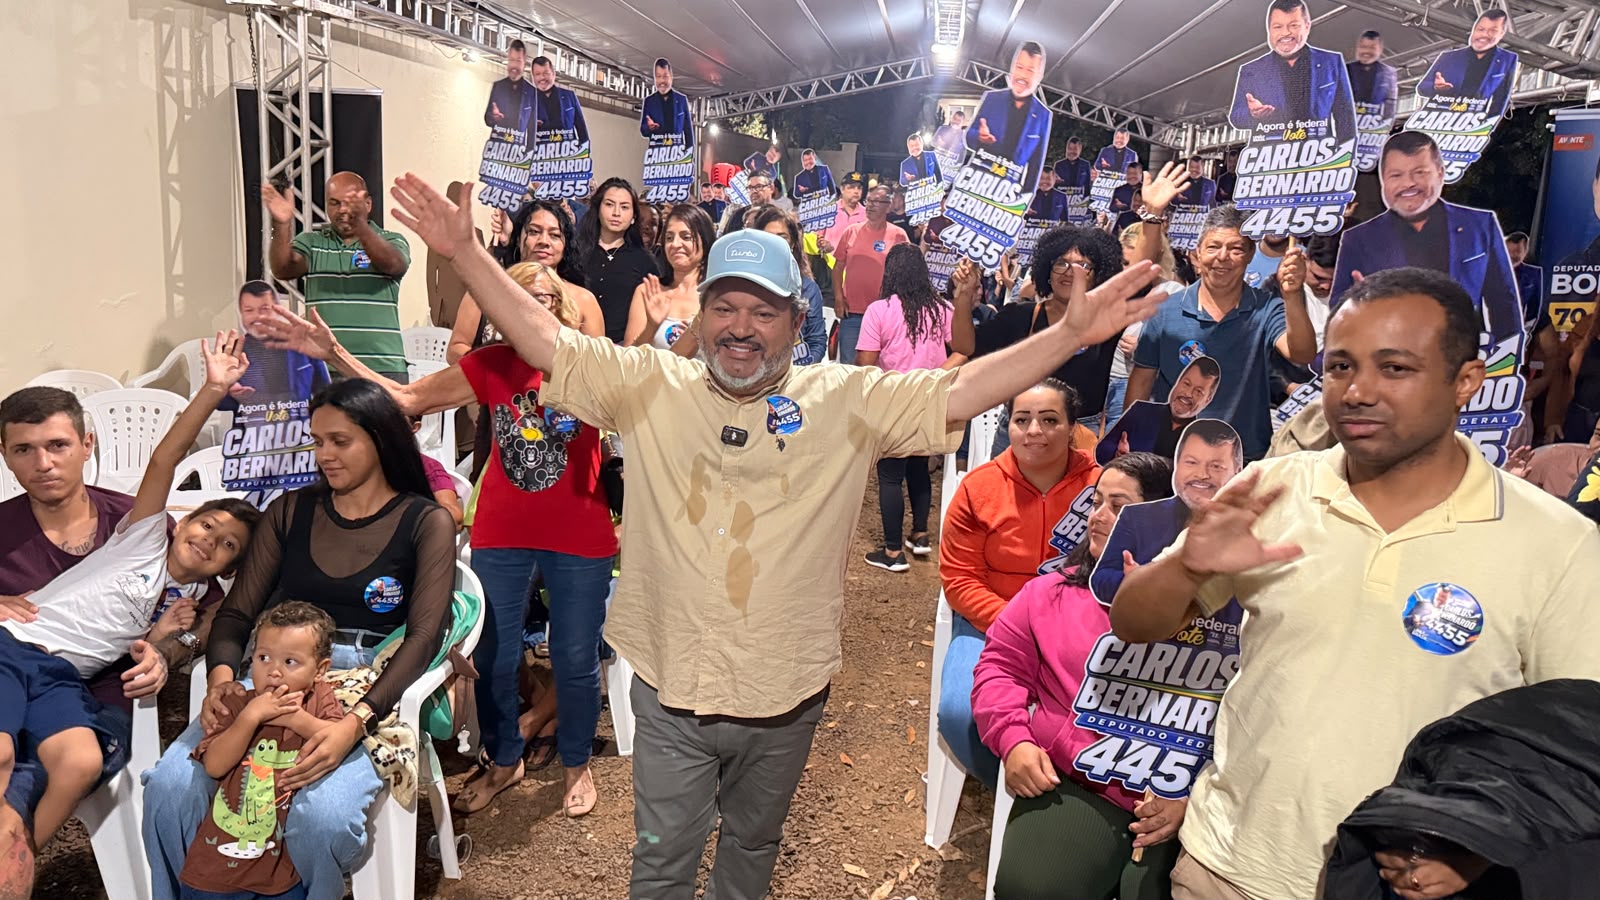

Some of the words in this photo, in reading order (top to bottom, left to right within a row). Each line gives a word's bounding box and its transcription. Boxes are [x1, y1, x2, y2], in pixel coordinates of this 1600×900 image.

[1256, 122, 1285, 133] Agora
[1287, 120, 1294, 129] é
[1296, 118, 1328, 128] federal
[1406, 110, 1487, 132] CARLOS
[1282, 128, 1306, 141] Vote
[1426, 132, 1488, 152] NARDO
[484, 140, 526, 164] CARLOS
[644, 145, 686, 165] CARLOS
[1238, 138, 1336, 174] CARLOS
[480, 160, 530, 186] BERNARDO
[531, 158, 590, 176] BERNARDO
[643, 164, 693, 180] BERNARDO
[536, 180, 588, 198] 4455
[906, 182, 937, 202] CARLOS
[956, 166, 1022, 203] CARLOS
[1235, 168, 1353, 198] BERNARDO
[480, 186, 522, 212] 4455
[646, 184, 688, 202] 4455
[906, 192, 944, 212] BERNARDO
[1243, 197, 1294, 206] DEPUTADO
[1300, 195, 1345, 203] FEDERAL
[799, 194, 830, 213] CARLOS
[800, 204, 836, 221] BERNARDO
[947, 189, 1022, 236] BERNARDO
[804, 216, 835, 232] 4455
[910, 207, 942, 225] 4455
[1242, 205, 1341, 236] 4455
[942, 222, 1004, 266] 4455
[1171, 238, 1198, 250] 445
[924, 250, 958, 265] CARLOS
[238, 402, 267, 414] Agora
[269, 402, 276, 410] é
[277, 399, 309, 410] federal
[265, 409, 289, 422] Vote
[776, 412, 800, 426] 4455
[1460, 416, 1508, 425] DERAL
[223, 419, 312, 456] CARLOS
[233, 478, 284, 488] DEPUTADO
[290, 476, 314, 484] FEDE
[377, 596, 400, 604] 4455
[1173, 627, 1204, 646] ote
[1426, 620, 1470, 646] 4455
[1089, 635, 1240, 690] CARLOS
[1076, 676, 1216, 736] BERNAR
[1088, 716, 1168, 740] DEPUTADO
[1176, 736, 1214, 752] FEDE
[1078, 736, 1206, 793] 445
